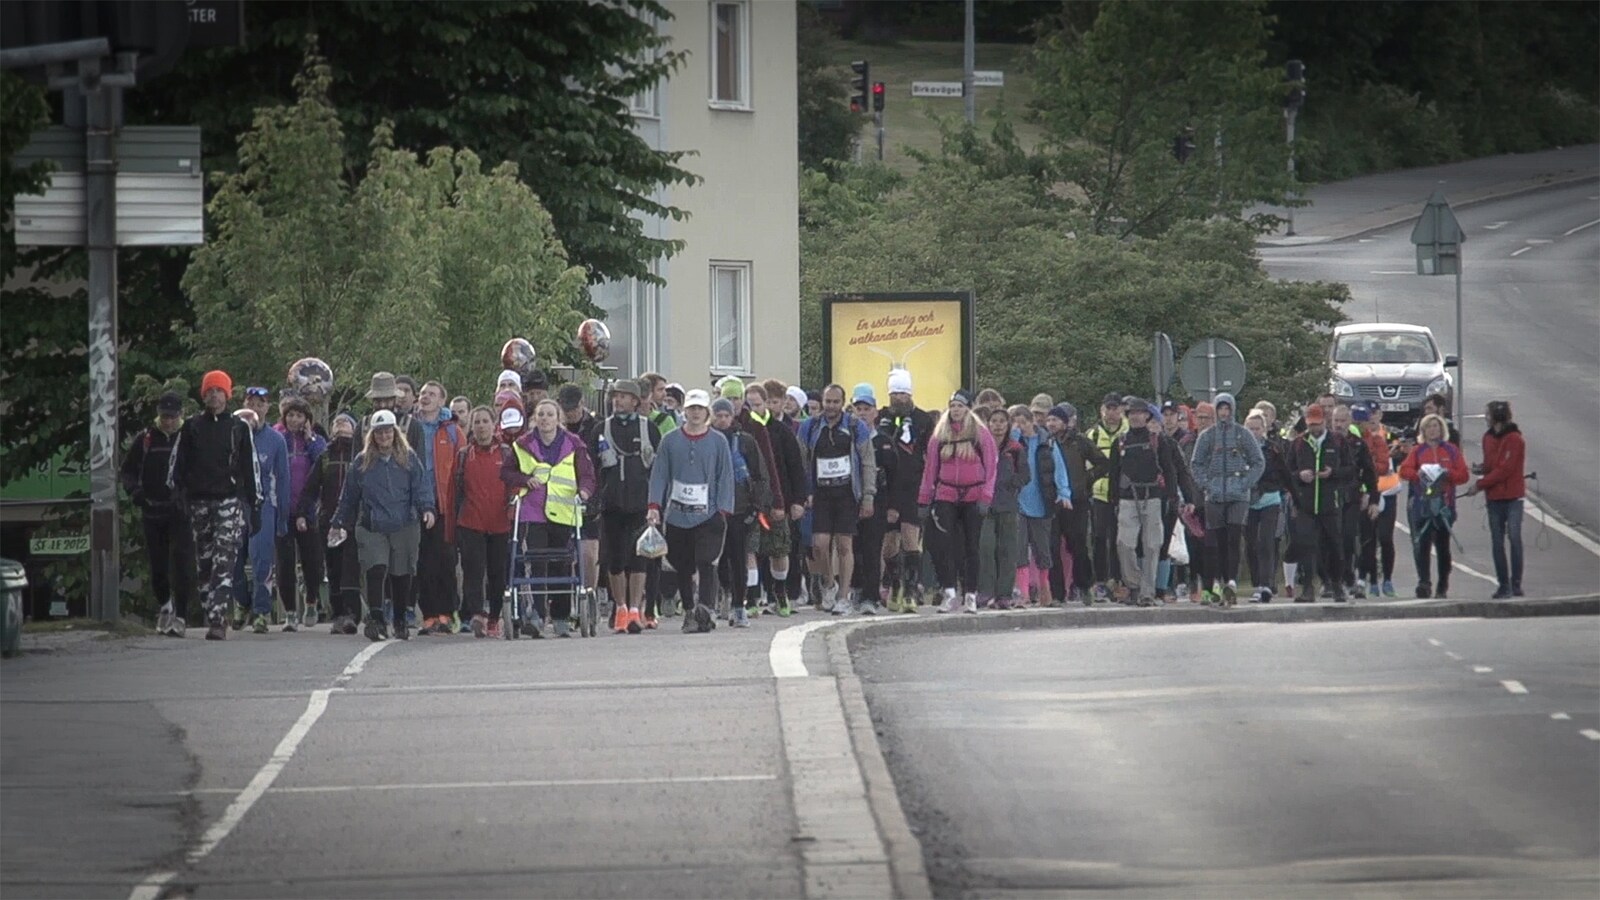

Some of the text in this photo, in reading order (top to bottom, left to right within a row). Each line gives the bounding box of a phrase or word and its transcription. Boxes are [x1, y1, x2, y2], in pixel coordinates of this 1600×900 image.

[856, 319, 869, 331] En
[918, 310, 936, 323] och
[849, 324, 944, 345] svalkande debutant
[682, 487, 694, 496] 42
